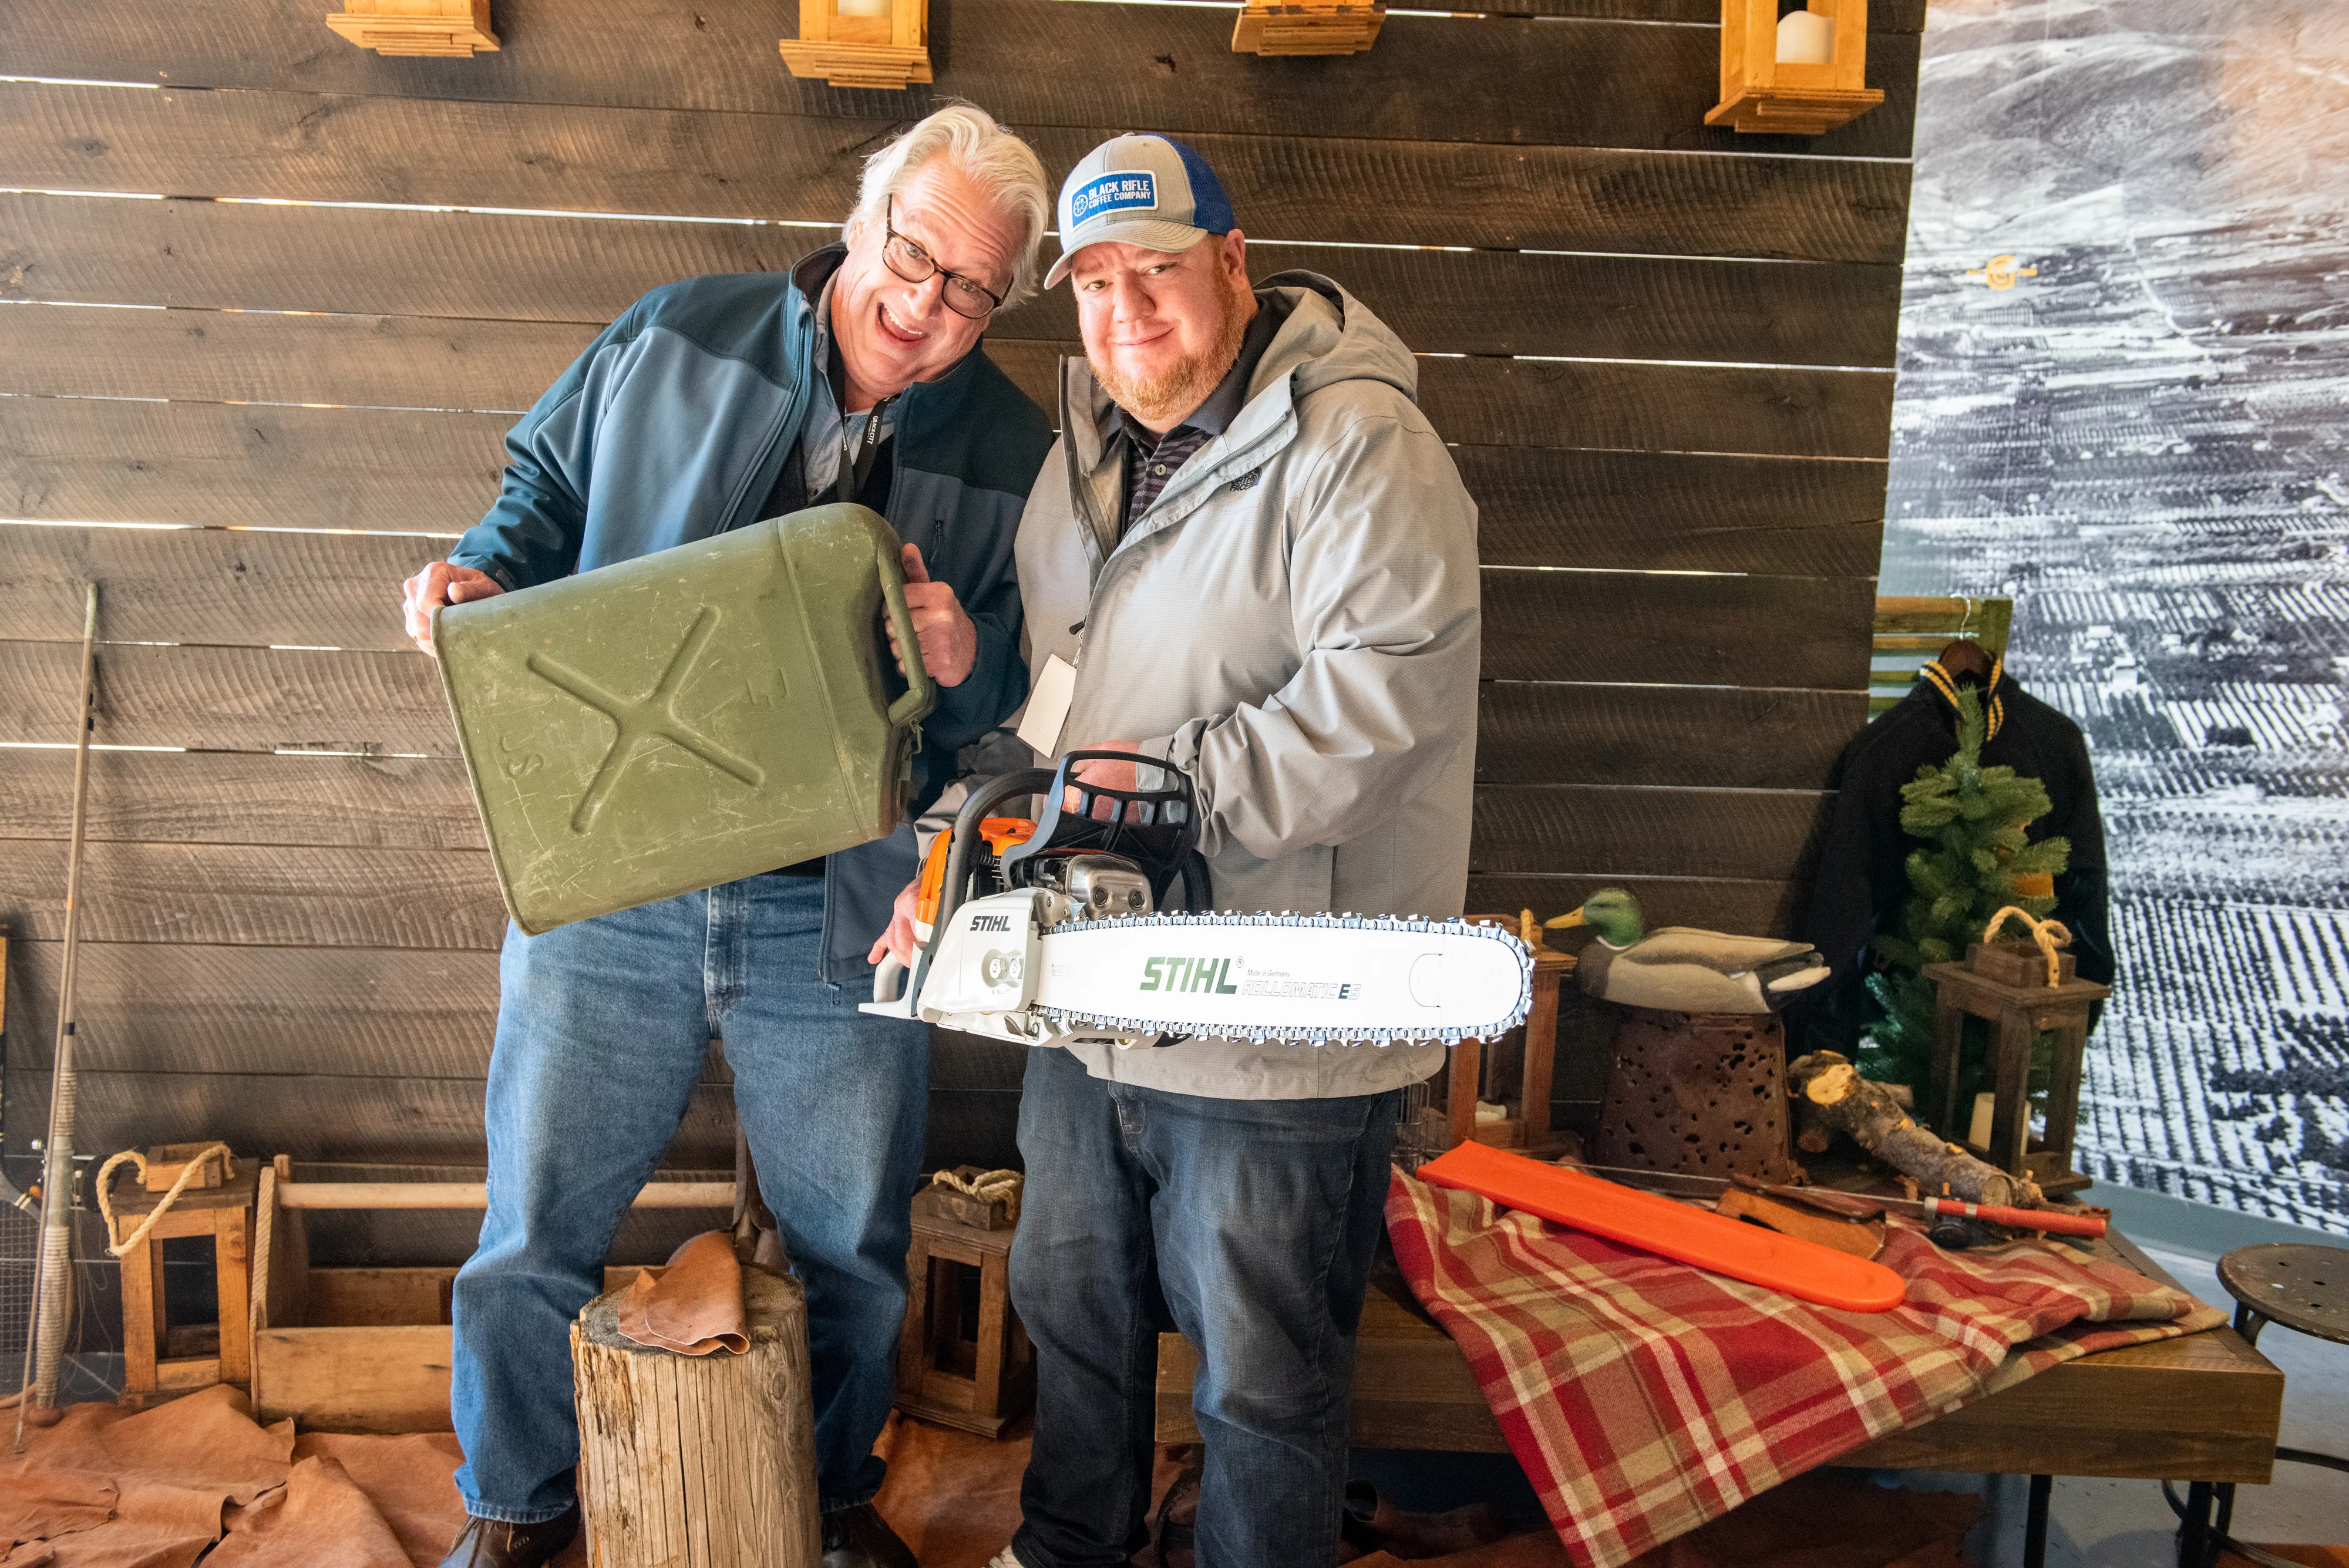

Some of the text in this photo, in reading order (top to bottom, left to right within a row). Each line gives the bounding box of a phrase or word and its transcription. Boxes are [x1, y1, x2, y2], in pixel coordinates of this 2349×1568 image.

[1089, 180, 1150, 200] BLACK RIFLE
[1088, 191, 1151, 209] COFFEE COMPANY
[867, 432, 875, 445] CITY
[1229, 482, 1250, 492] FACE
[970, 916, 1011, 932] STIHL
[1139, 956, 1237, 994] STIHL
[1267, 970, 1290, 978] Germany
[1241, 980, 1338, 999] ROLLOMATIC
